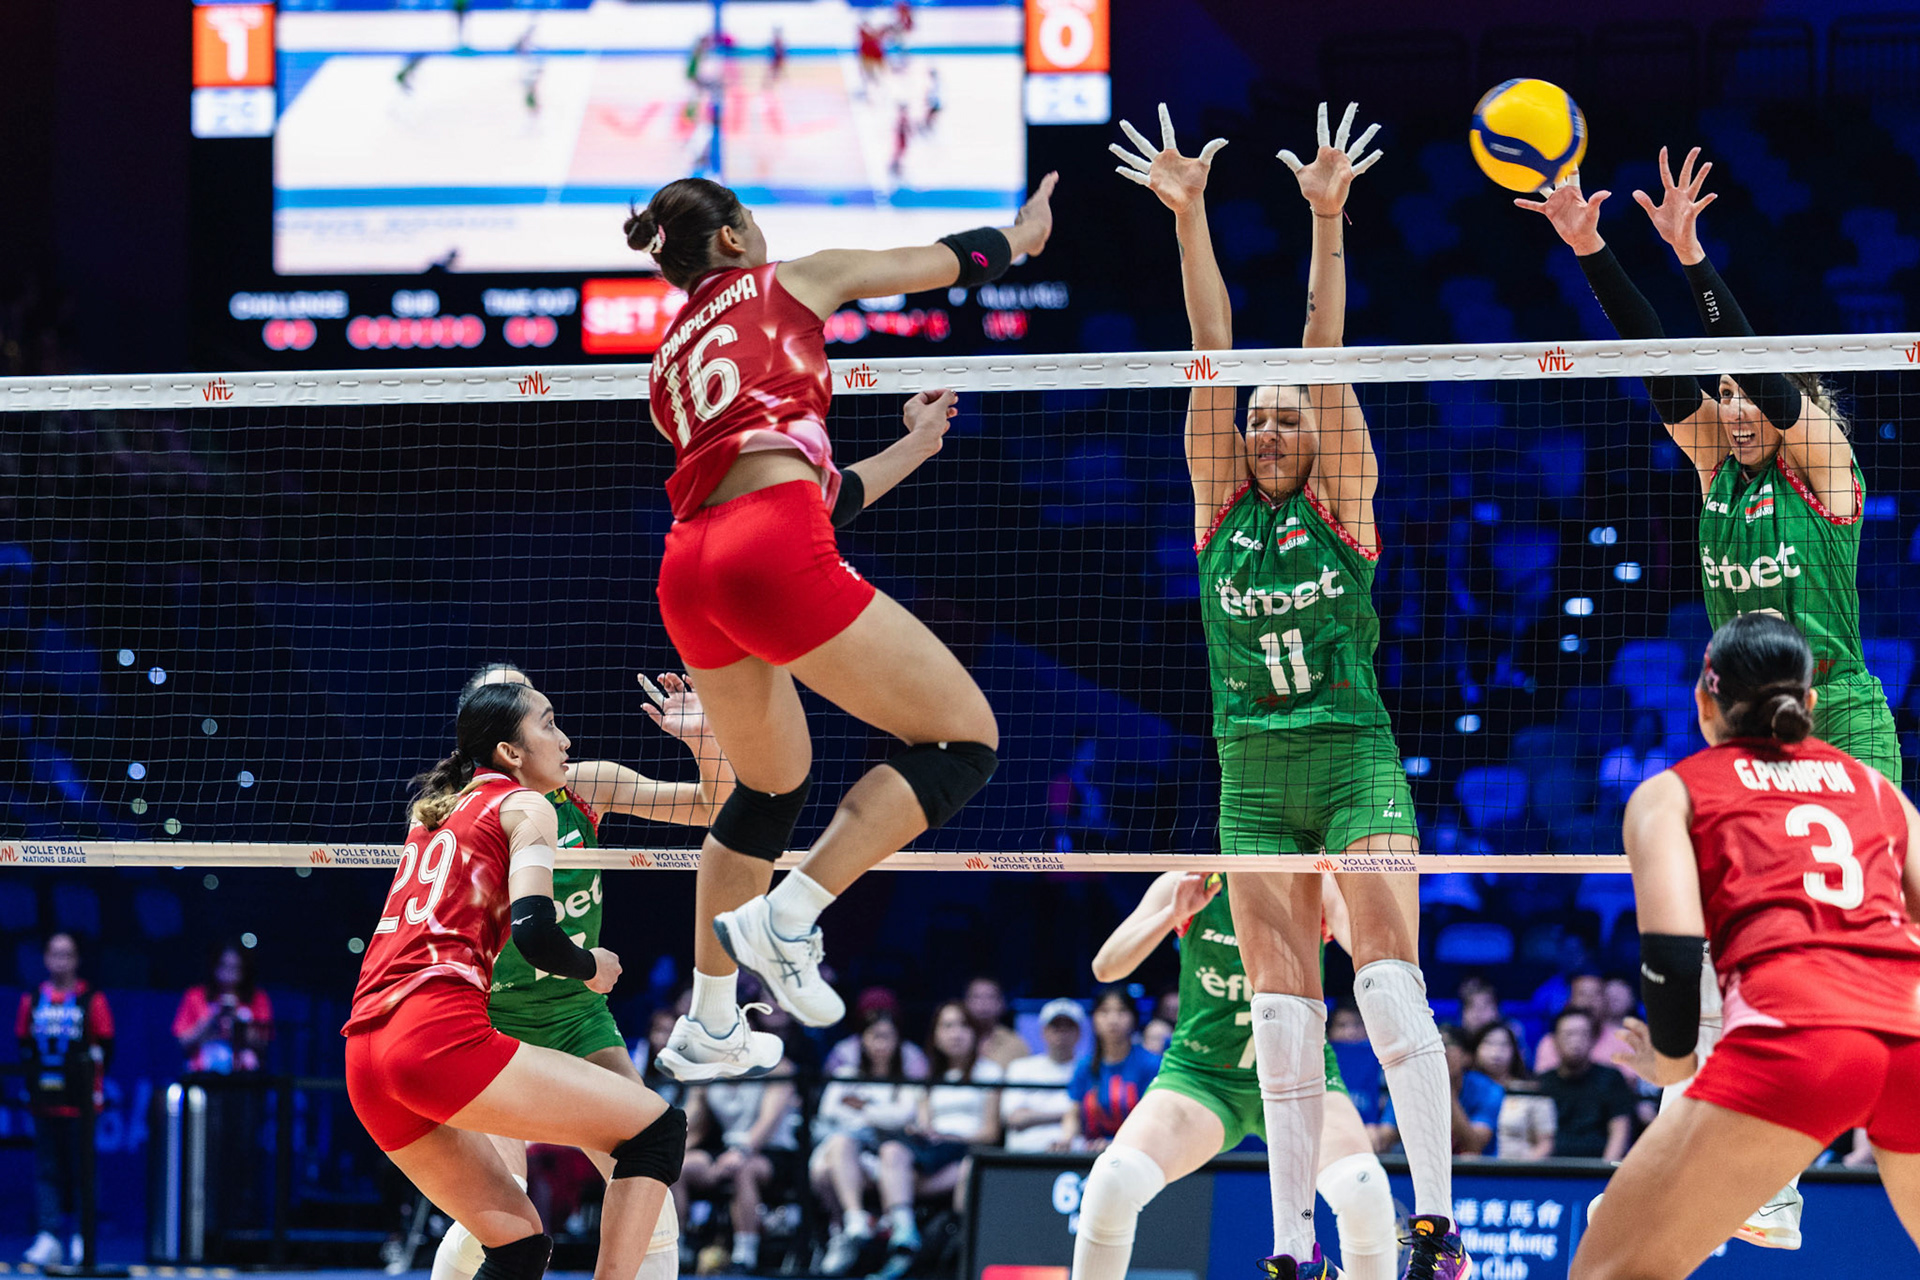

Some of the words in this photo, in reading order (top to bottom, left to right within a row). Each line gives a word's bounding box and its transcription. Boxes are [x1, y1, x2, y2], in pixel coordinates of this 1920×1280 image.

[1702, 289, 1720, 323] KIPSTA
[1184, 354, 1219, 380] VNL
[518, 371, 551, 395] VNL
[664, 323, 740, 449] 16
[1259, 628, 1311, 696] 11
[21, 845, 86, 855] VOLLEYBALL
[309, 848, 331, 864] VNL
[332, 848, 400, 857] VOLLEYBALL
[1784, 803, 1865, 910] 3
[22, 856, 56, 864] NATIONS
[59, 856, 87, 864] LEAGUE
[335, 857, 370, 865] NATIONS
[628, 852, 652, 867] VNL
[964, 856, 989, 869] VNL
[989, 856, 1063, 864] VOLLEYBALL
[1313, 858, 1339, 872] VNL
[1339, 858, 1415, 866] VOLLEYBALL
[374, 828, 457, 935] 29
